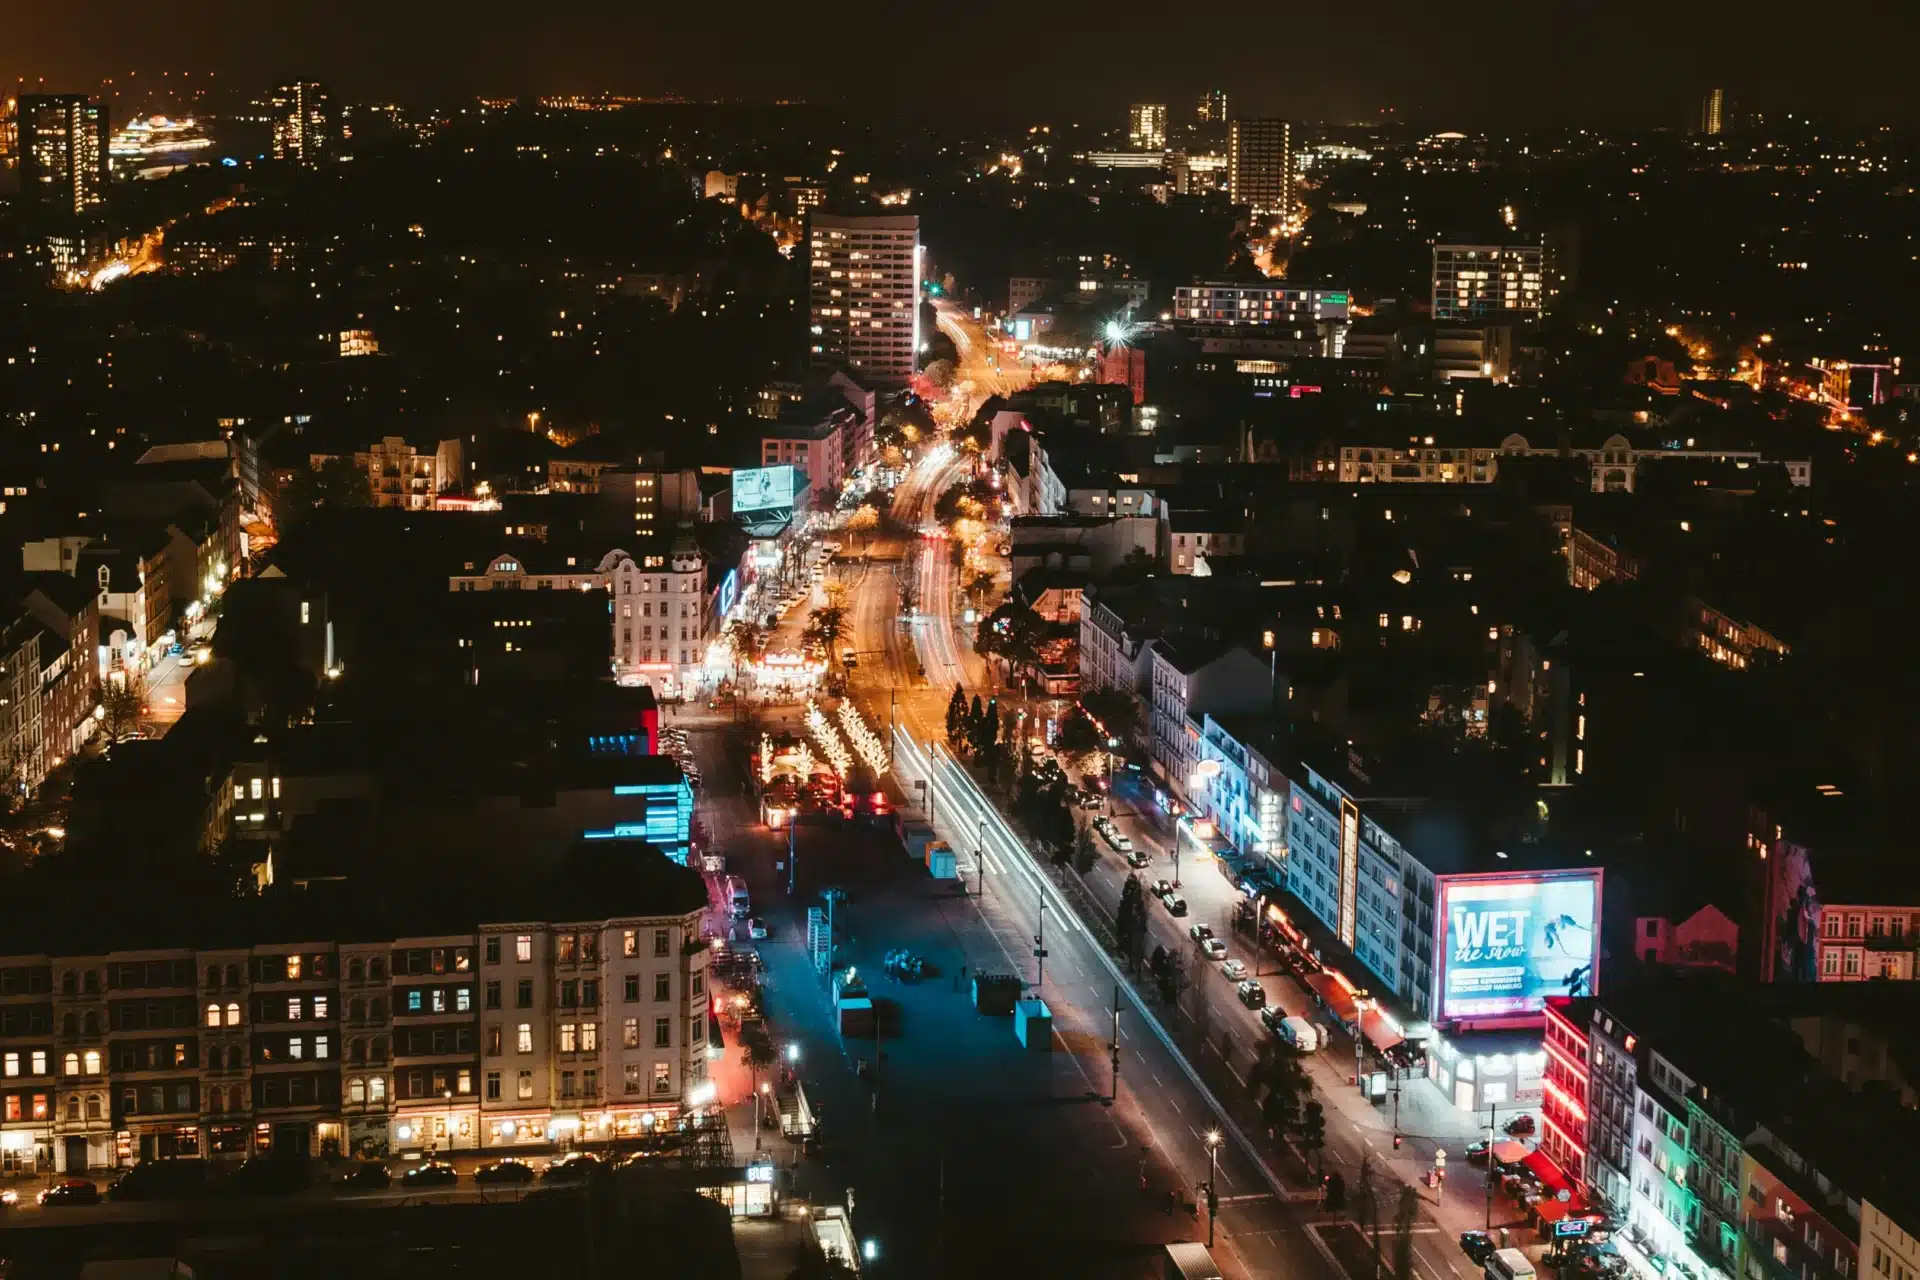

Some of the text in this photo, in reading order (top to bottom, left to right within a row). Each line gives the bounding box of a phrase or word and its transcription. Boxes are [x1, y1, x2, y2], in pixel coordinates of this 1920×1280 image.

[1453, 910, 1531, 948] WET
[1454, 942, 1528, 963] the show
